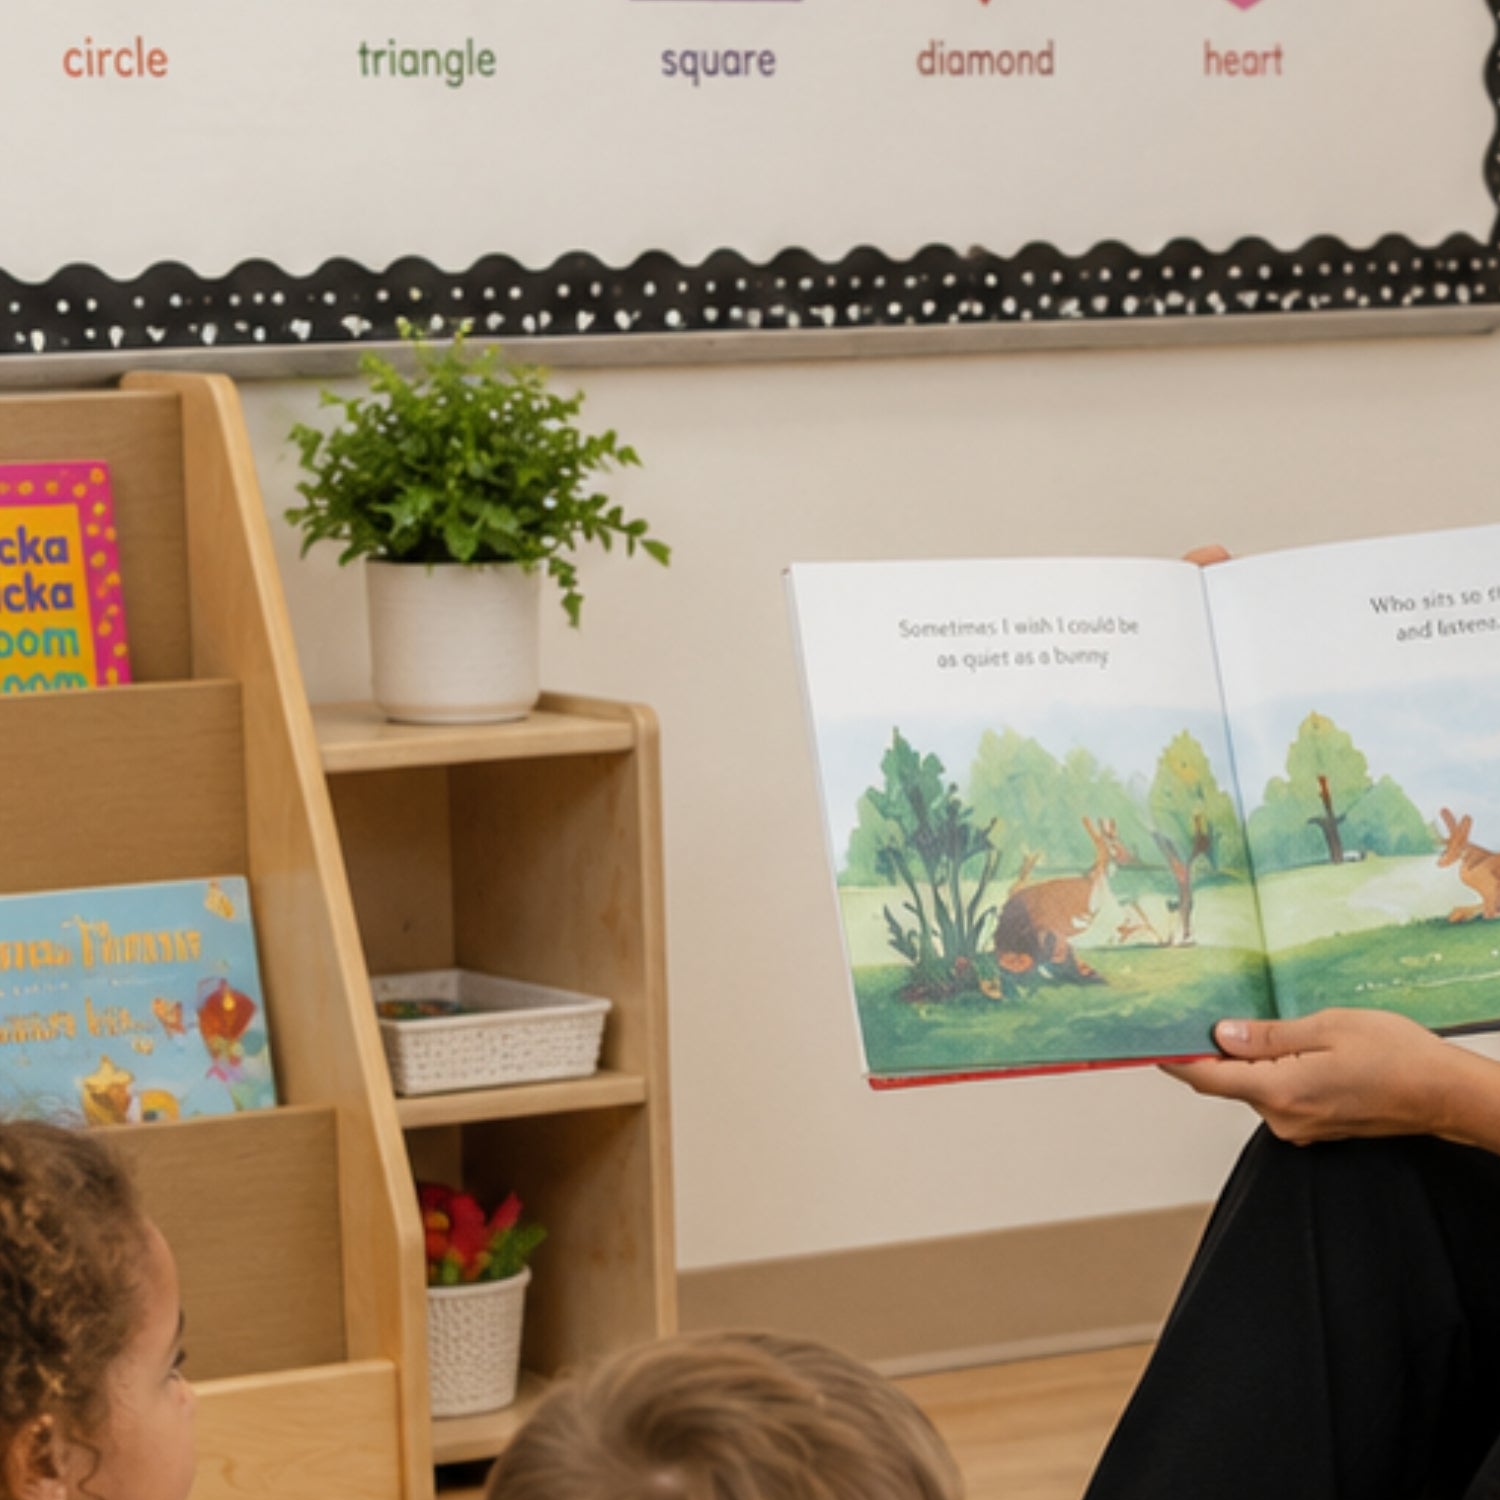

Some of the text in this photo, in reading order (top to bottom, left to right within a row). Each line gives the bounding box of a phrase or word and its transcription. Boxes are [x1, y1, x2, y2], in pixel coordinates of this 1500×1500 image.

[62, 35, 169, 78] circle
[357, 37, 497, 89] triangle
[661, 49, 777, 88] square
[916, 39, 1055, 77] diamond
[1203, 39, 1284, 77] heart
[1369, 595, 1417, 615] Who
[1459, 590, 1483, 606] so
[898, 616, 1140, 639] Sometimes I wish I could be
[1396, 620, 1433, 642] and
[936, 646, 1110, 673] as quiet as a bunny
